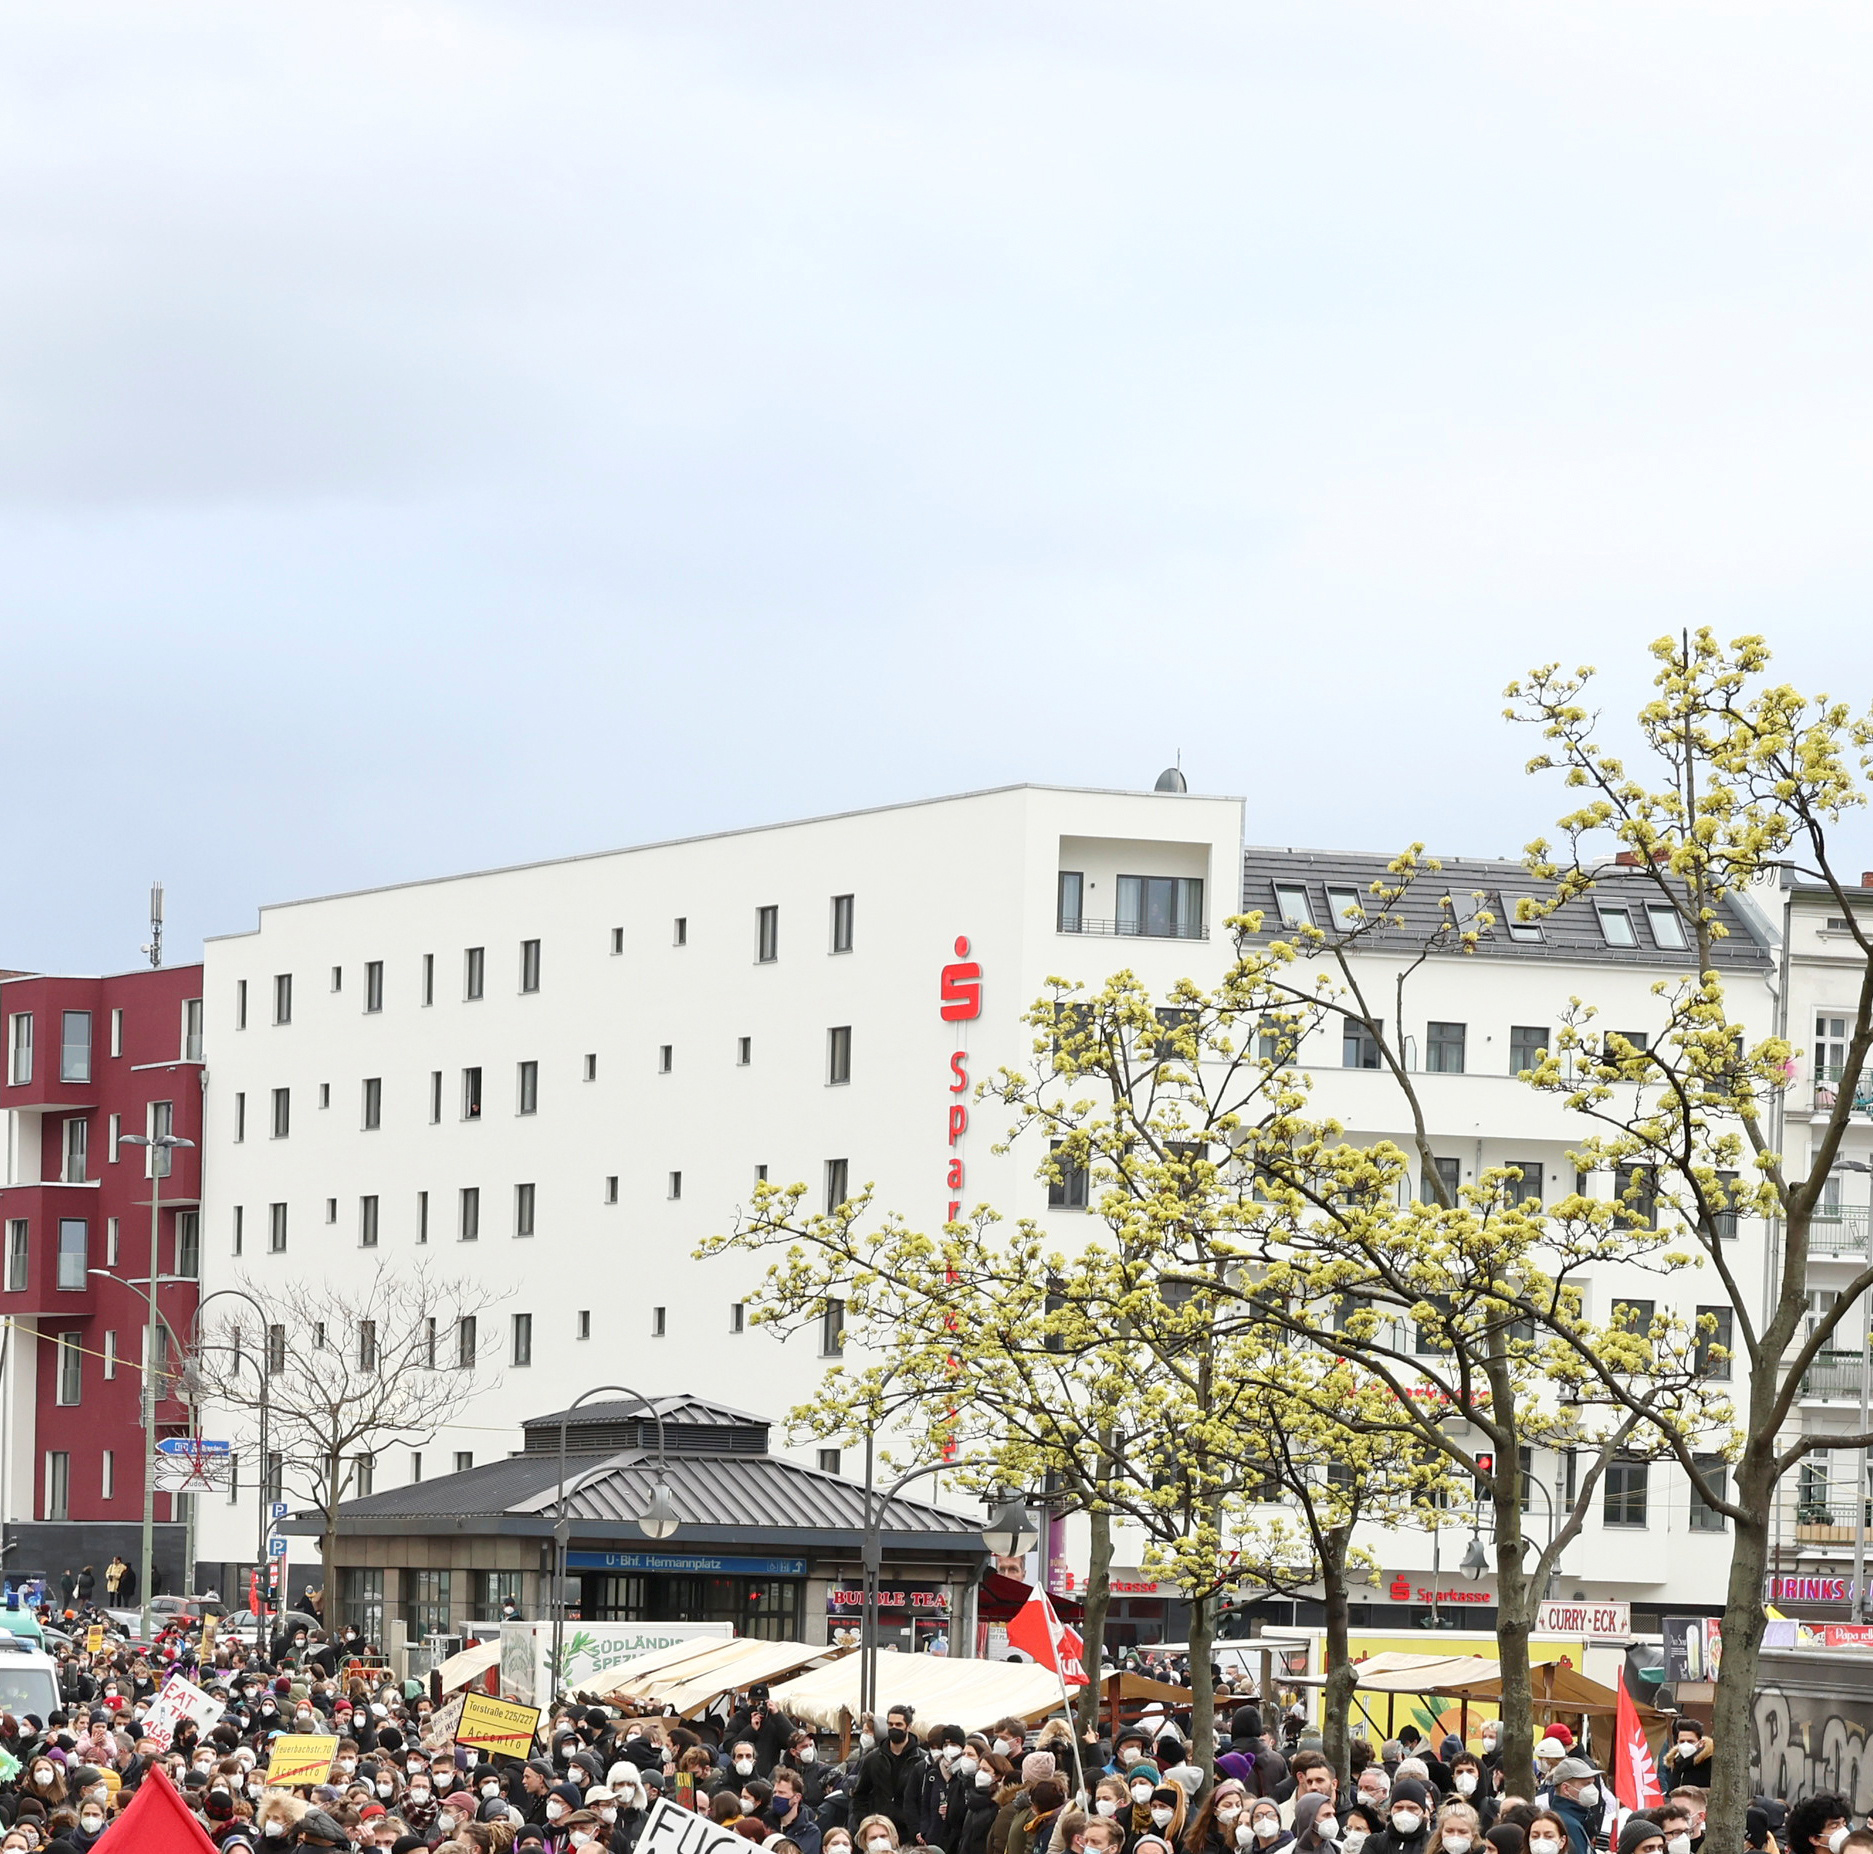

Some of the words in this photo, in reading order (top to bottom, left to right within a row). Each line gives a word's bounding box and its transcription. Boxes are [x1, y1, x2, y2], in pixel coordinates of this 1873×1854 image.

[943, 1050, 969, 1463] Spark
[645, 1556, 723, 1571] Hermannplatz
[1082, 1577, 1159, 1593] Srkasse
[1416, 1588, 1492, 1604] Sparkasse
[1768, 1576, 1845, 1602] DRINKS
[909, 1592, 949, 1608] TEA
[1548, 1608, 1588, 1632] CURRY
[1593, 1609, 1617, 1633] ECK
[591, 1634, 684, 1659] SÜDLÄNDI
[1835, 1627, 1859, 1642] Papa
[591, 1653, 648, 1673] SPEZ
[162, 1681, 198, 1707] EAT
[468, 1699, 504, 1720] Torstraße
[503, 1705, 534, 1727] 225/227
[140, 1720, 173, 1744] ALSO
[467, 1726, 522, 1751] Accentro
[274, 1764, 320, 1779] Accentro
